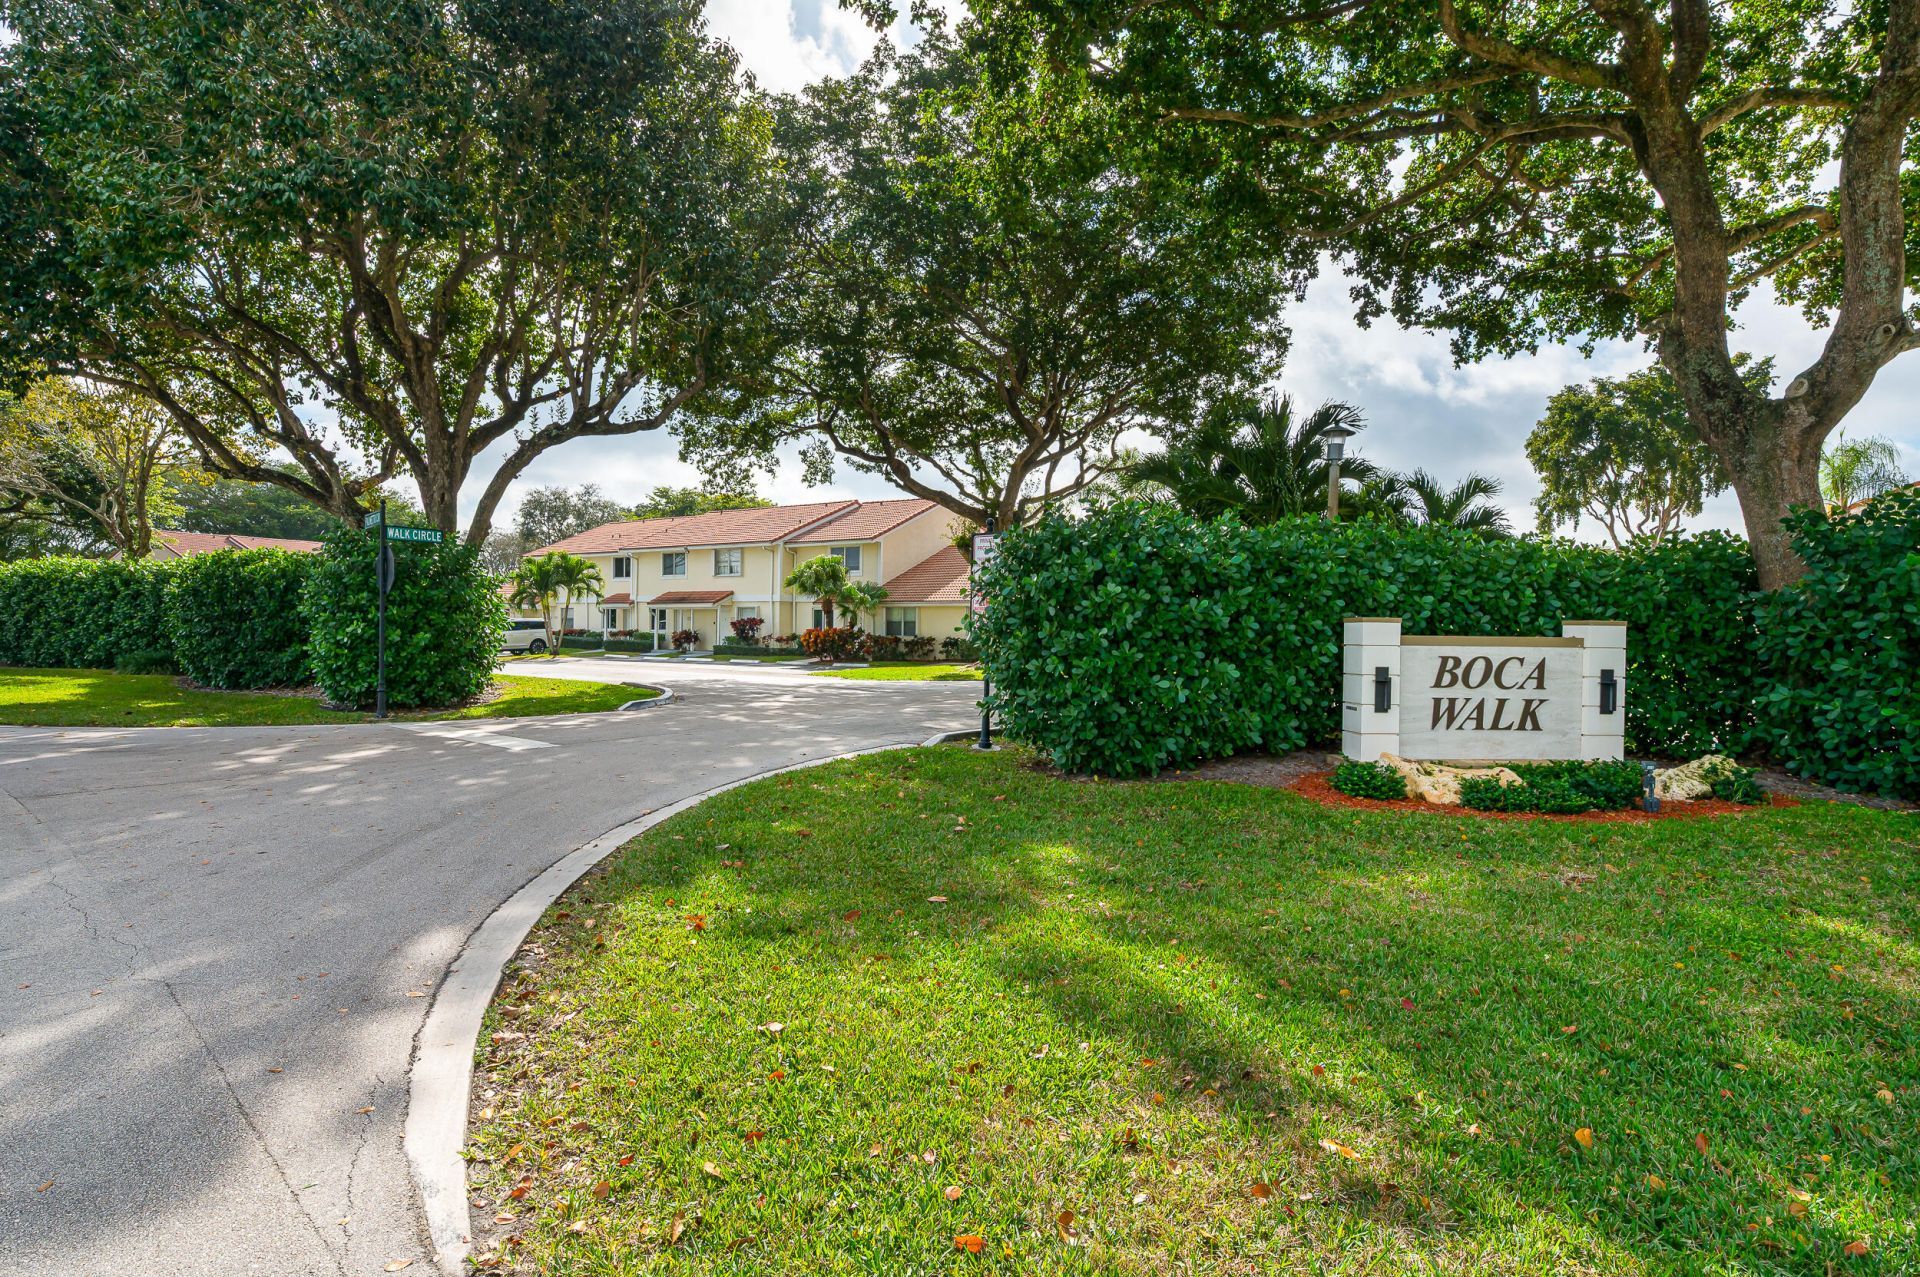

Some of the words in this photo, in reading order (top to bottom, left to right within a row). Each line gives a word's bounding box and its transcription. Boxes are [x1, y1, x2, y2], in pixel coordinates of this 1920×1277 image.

[387, 527, 409, 539] WALK
[412, 531, 442, 542] CIRCLE
[1430, 655, 1546, 689] BOCA
[1430, 697, 1549, 731] WALK
